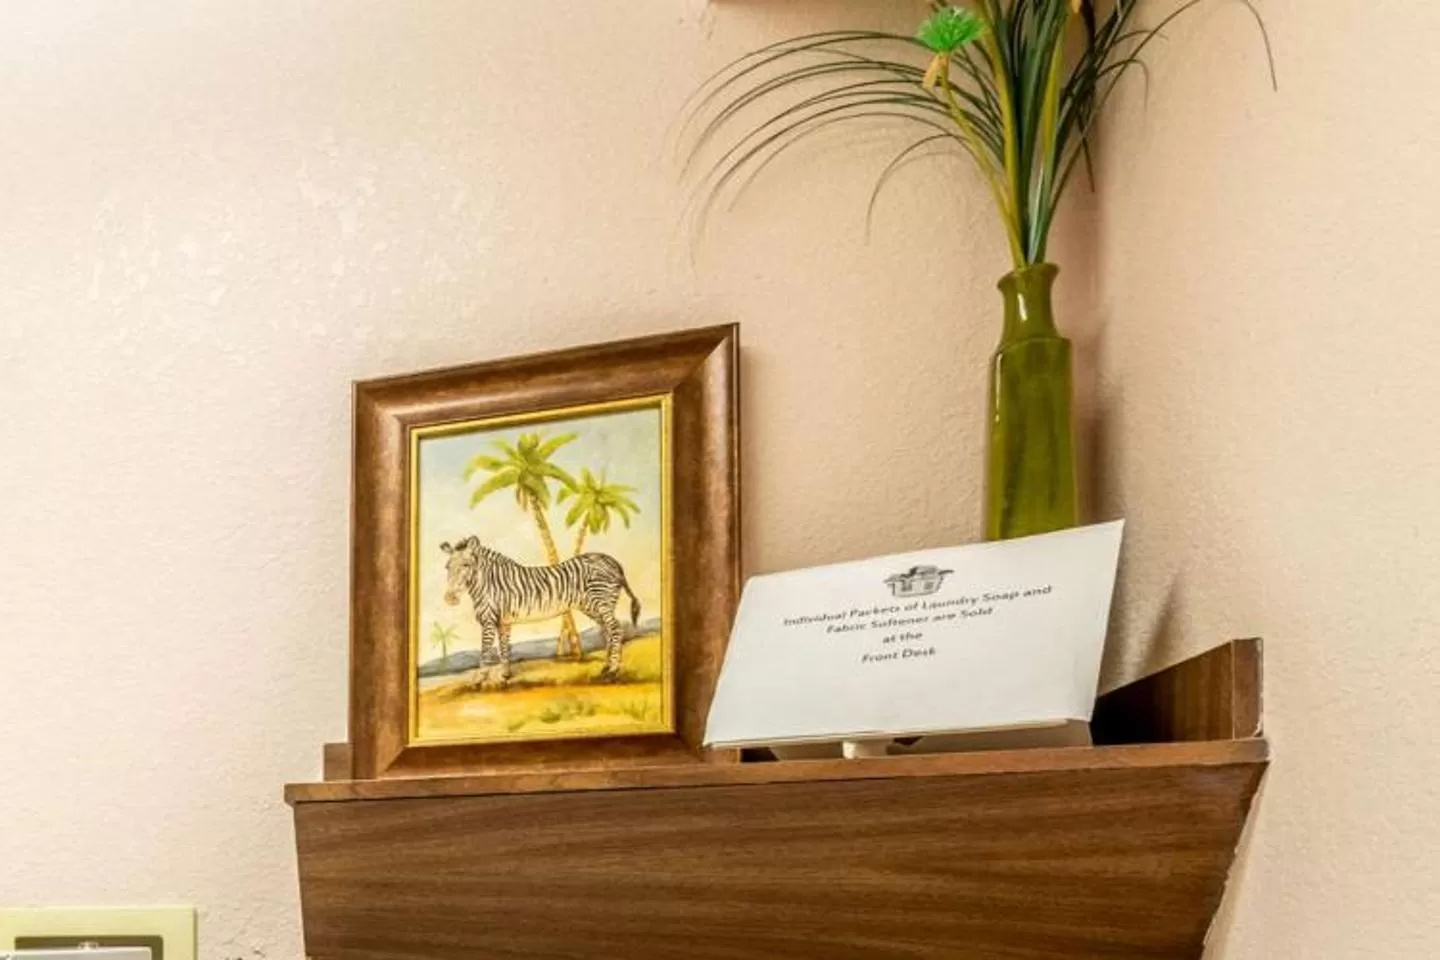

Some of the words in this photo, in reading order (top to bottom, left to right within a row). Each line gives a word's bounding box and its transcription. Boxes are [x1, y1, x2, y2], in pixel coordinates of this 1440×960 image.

[903, 601, 918, 611] of
[981, 591, 1019, 602] Soap
[1023, 584, 1052, 597] and
[826, 623, 866, 634] Fabric
[961, 606, 993, 618] Sold
[882, 634, 896, 644] at
[900, 631, 923, 642] the
[861, 651, 898, 664] Front
[901, 646, 936, 659] Desk
